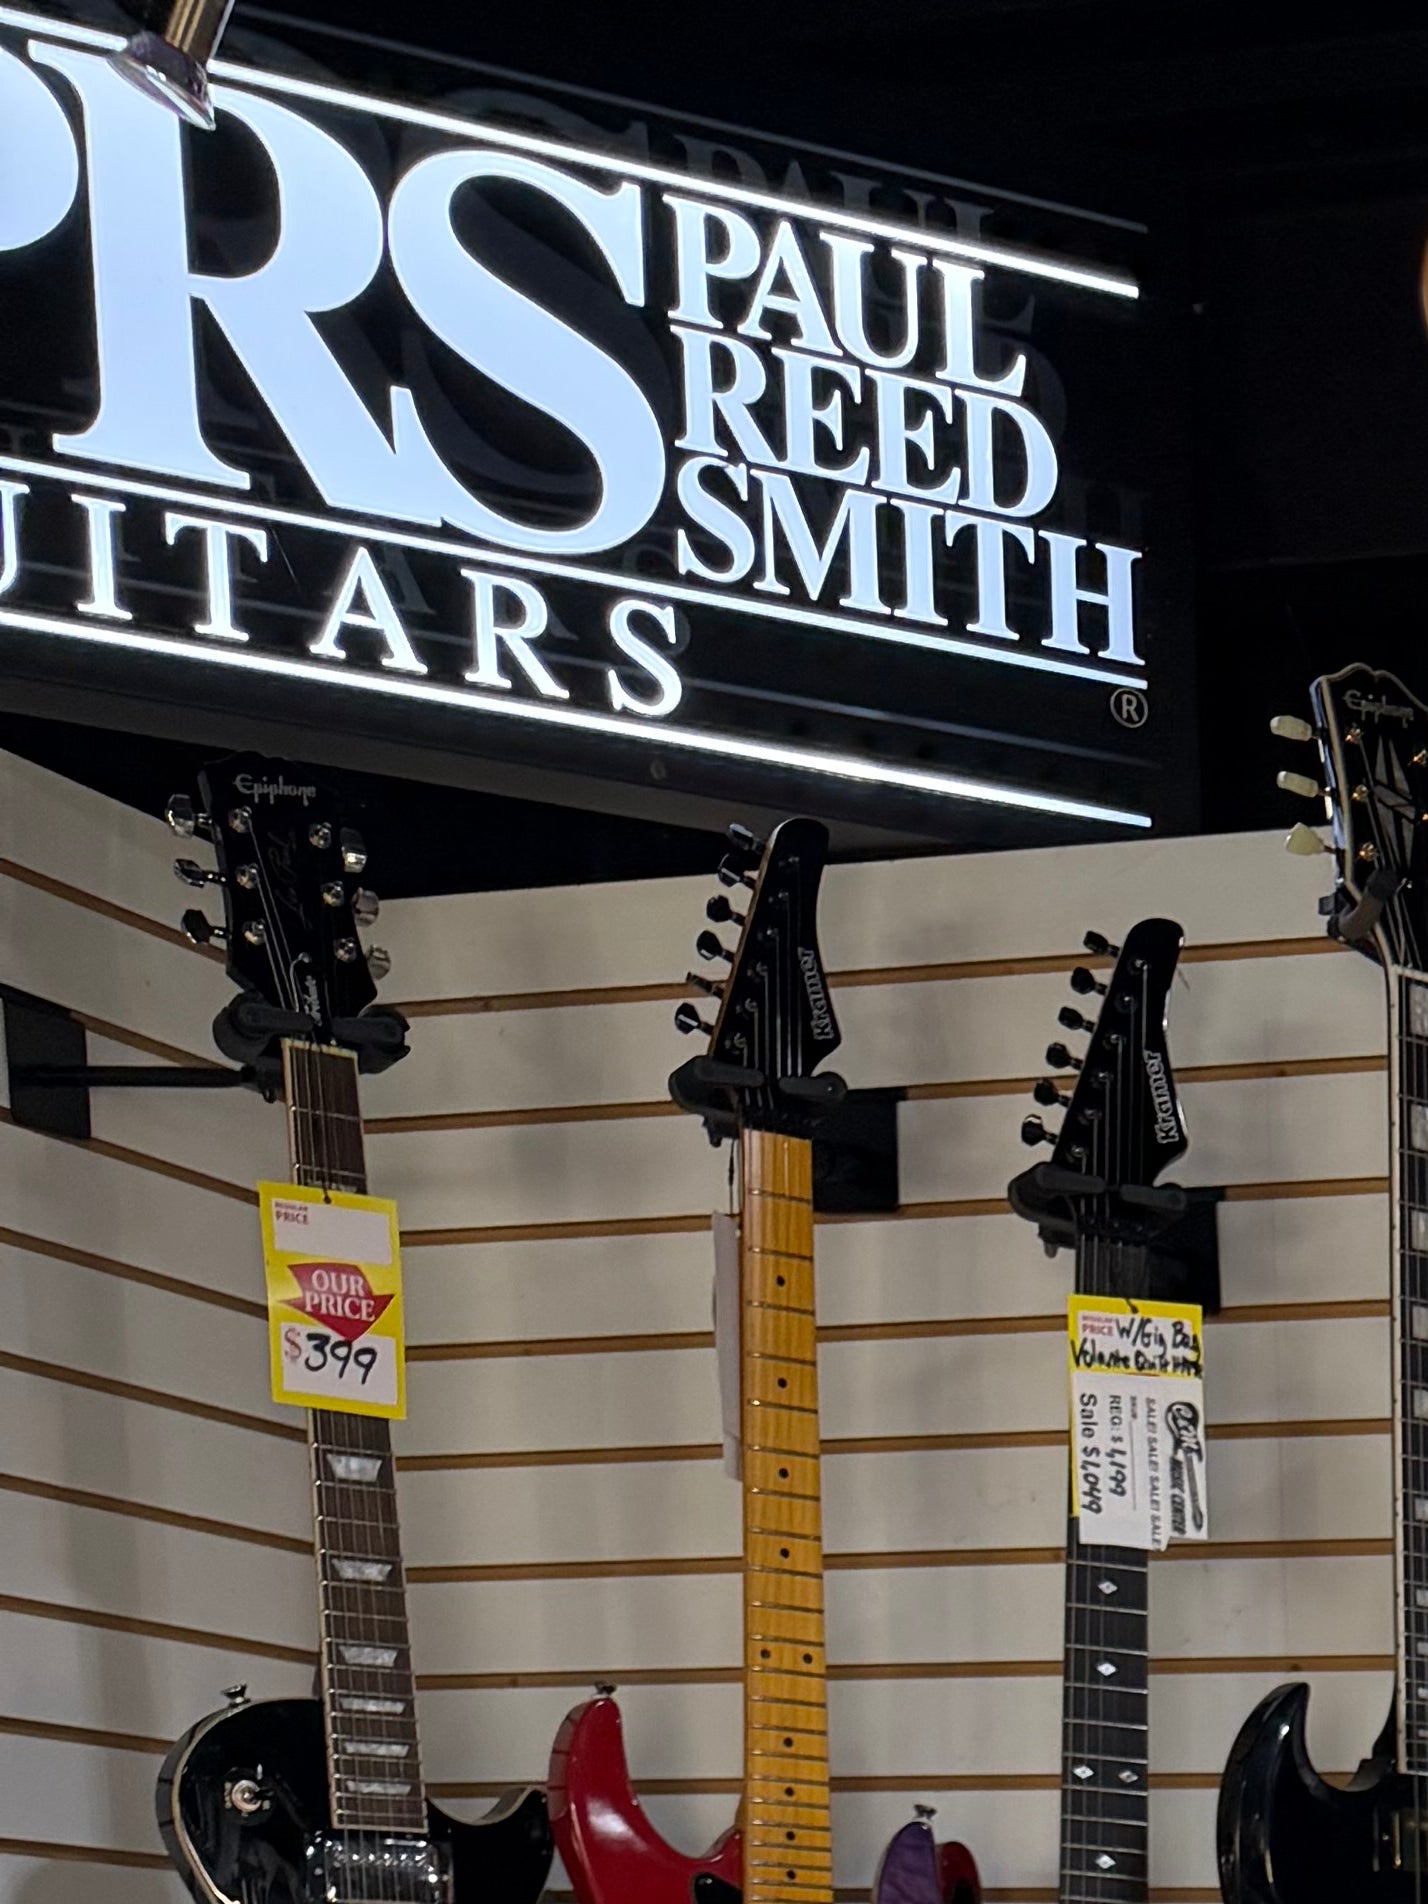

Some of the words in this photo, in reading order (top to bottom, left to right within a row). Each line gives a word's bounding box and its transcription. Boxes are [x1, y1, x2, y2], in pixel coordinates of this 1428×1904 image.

[663, 191, 1031, 399] PAUL
[668, 323, 1061, 520] REED
[676, 459, 1147, 669] SMITH
[0, 482, 690, 721] ITARS
[232, 773, 317, 807] Epiphone
[797, 946, 835, 1040] Kramer
[1142, 1048, 1180, 1144] Kramer
[275, 1210, 310, 1226] PRICE
[304, 1291, 376, 1322] PRICE
[311, 1269, 367, 1297] OUR
[283, 1327, 378, 1385] $399
[1081, 1323, 1115, 1338] PRICE
[1079, 1392, 1099, 1439] Sale
[1080, 1446, 1103, 1515] $1,049
[1169, 1456, 1186, 1490] MUSIC
[1170, 1491, 1187, 1536] CENTER
